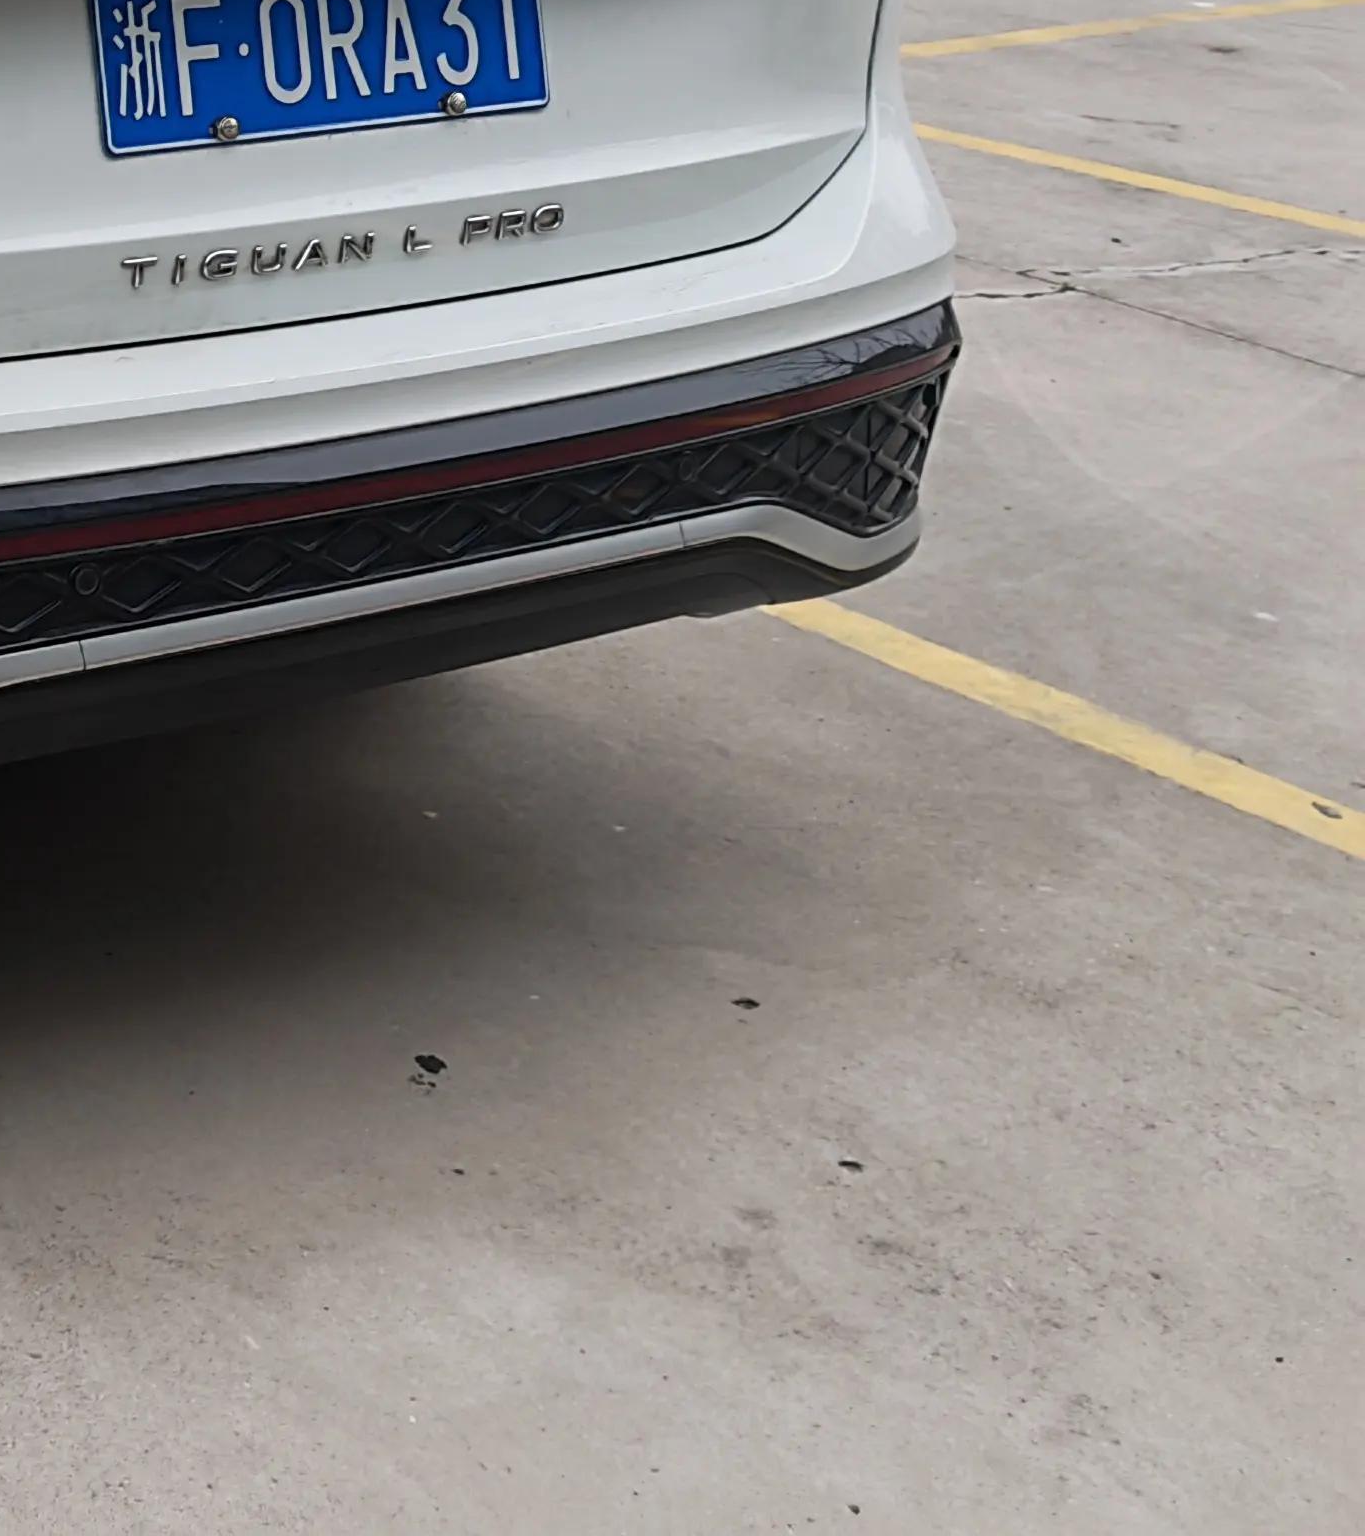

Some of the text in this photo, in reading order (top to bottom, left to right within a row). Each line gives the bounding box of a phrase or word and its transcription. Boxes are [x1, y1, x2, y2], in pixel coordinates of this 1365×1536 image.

[120, 202, 567, 290] TIGUAN L PRO
